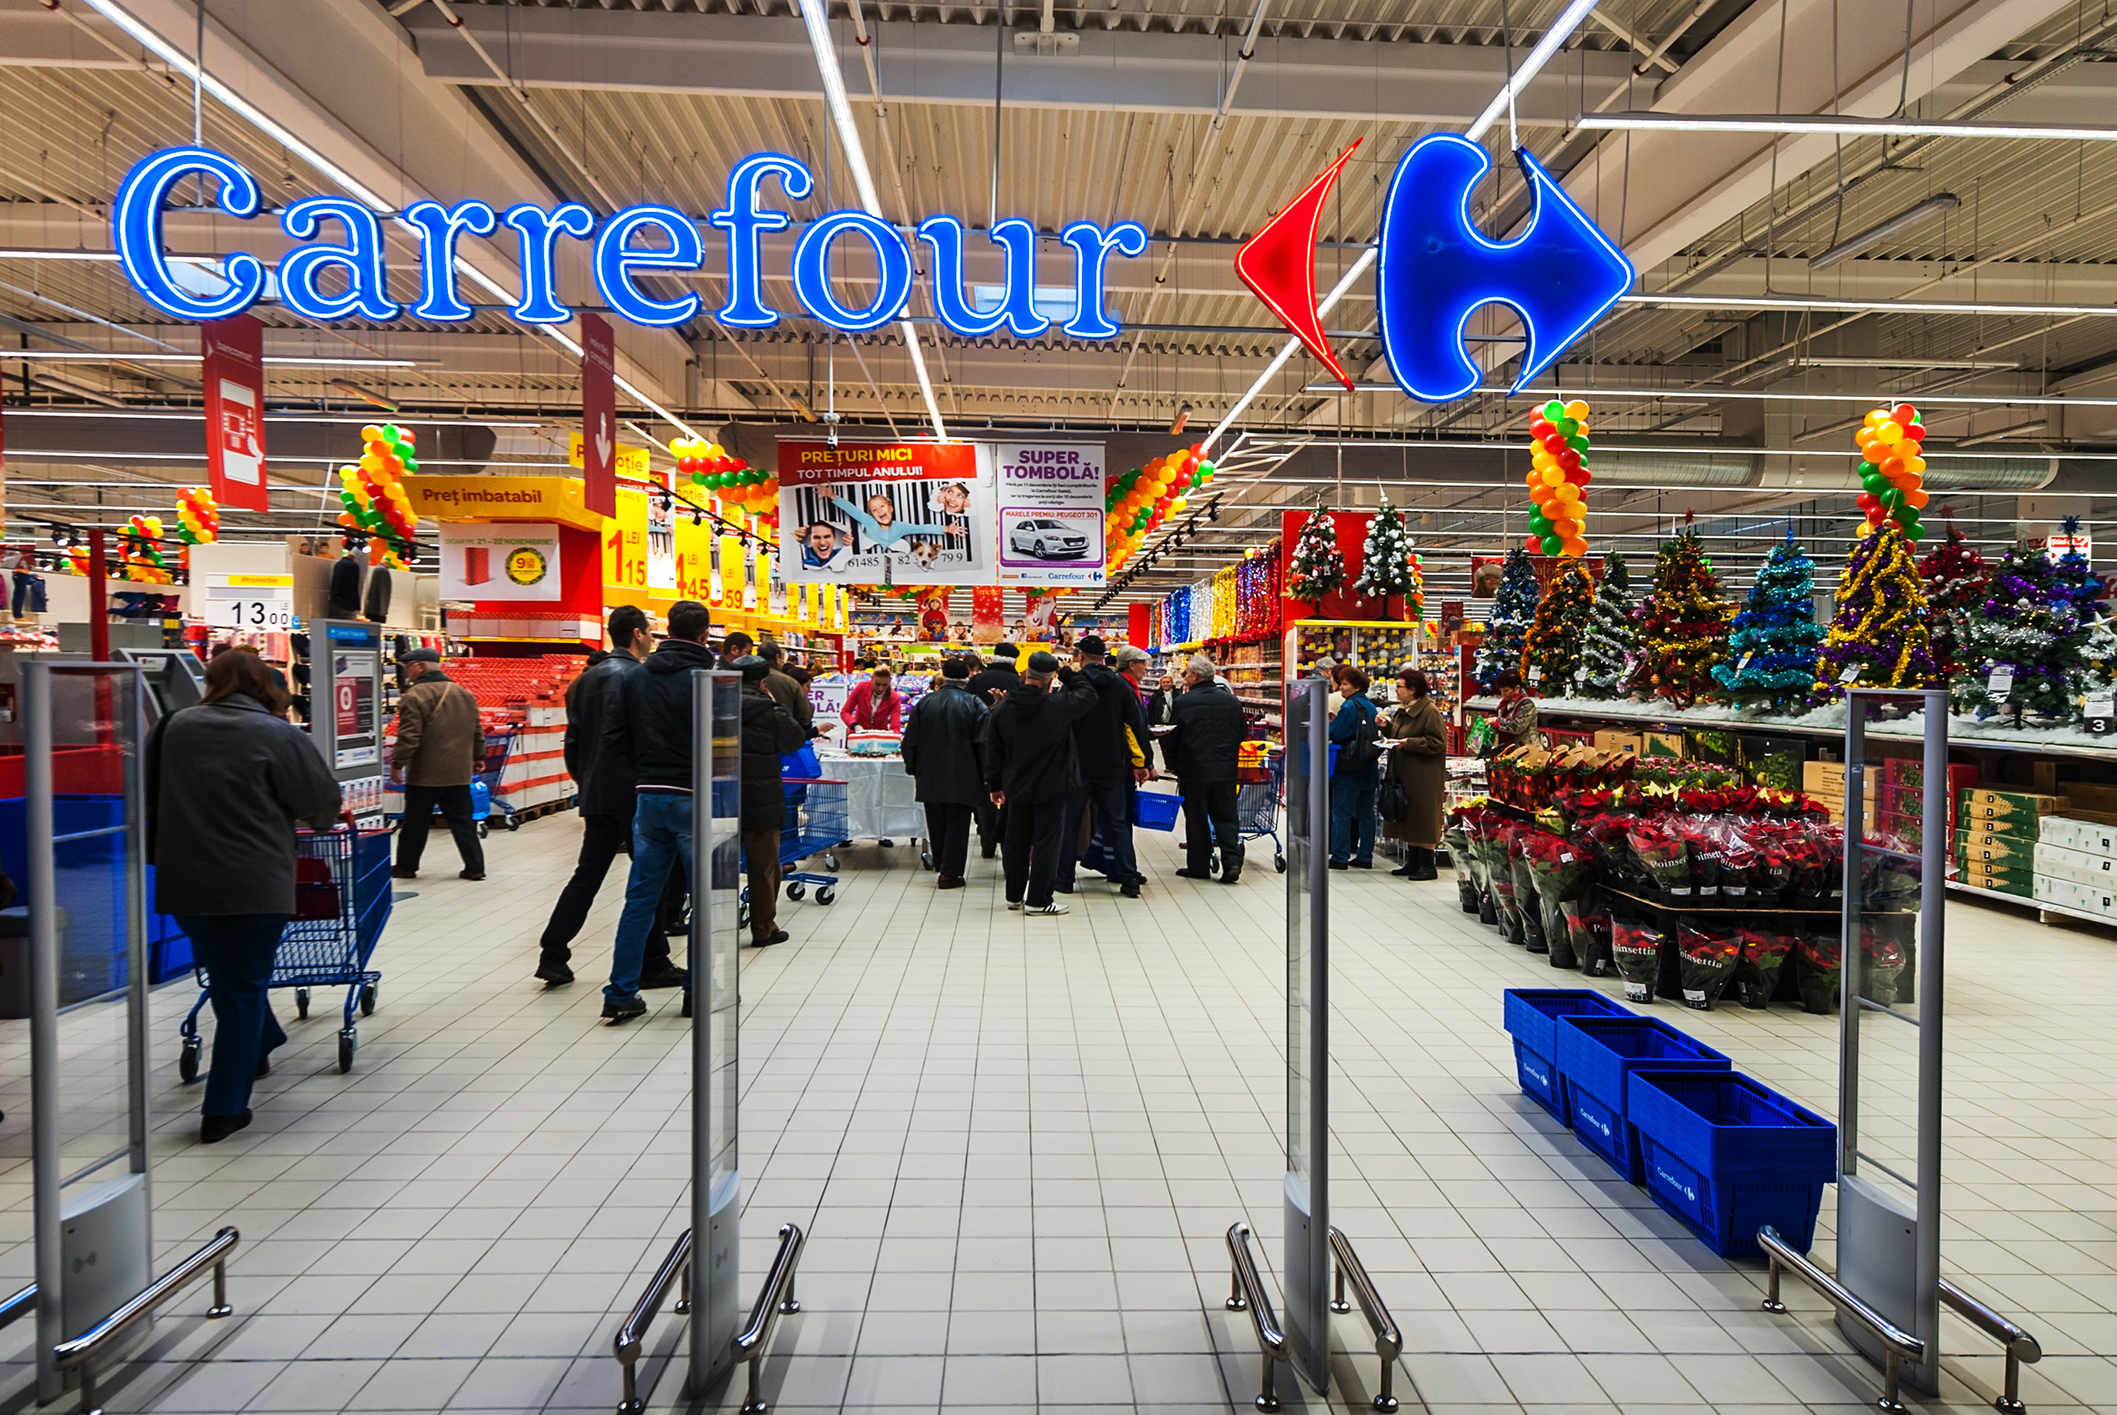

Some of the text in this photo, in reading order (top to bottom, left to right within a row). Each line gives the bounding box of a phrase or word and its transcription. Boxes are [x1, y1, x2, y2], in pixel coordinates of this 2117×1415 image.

[113, 146, 1148, 337] Carrefour
[801, 447, 912, 467] PREȚURI MICI
[1018, 449, 1080, 465] SUPER
[797, 465, 923, 480] TOT TIMPUL ANULUI!
[1002, 461, 1100, 480] TOMBOLĂ!
[422, 488, 542, 506] Preț imbatabil
[1056, 511, 1085, 519] PEUGEOT
[1086, 511, 1098, 519] 301
[516, 557, 526, 569] 9
[607, 529, 640, 583] 1 LEI
[687, 553, 699, 565] LEI
[848, 556, 880, 568] 61485
[625, 558, 646, 586] 15
[1047, 572, 1085, 580] Carrefour
[687, 577, 709, 600] 45
[725, 589, 743, 609] 59
[756, 596, 769, 615] 79
[231, 601, 266, 625] 13
[2092, 718, 2106, 733] 3
[1679, 949, 1723, 969] oinsettia
[1523, 1062, 1540, 1080] Carrefour
[1580, 1107, 1600, 1128] Carrefour
[1657, 1166, 1683, 1191] Carrefour
